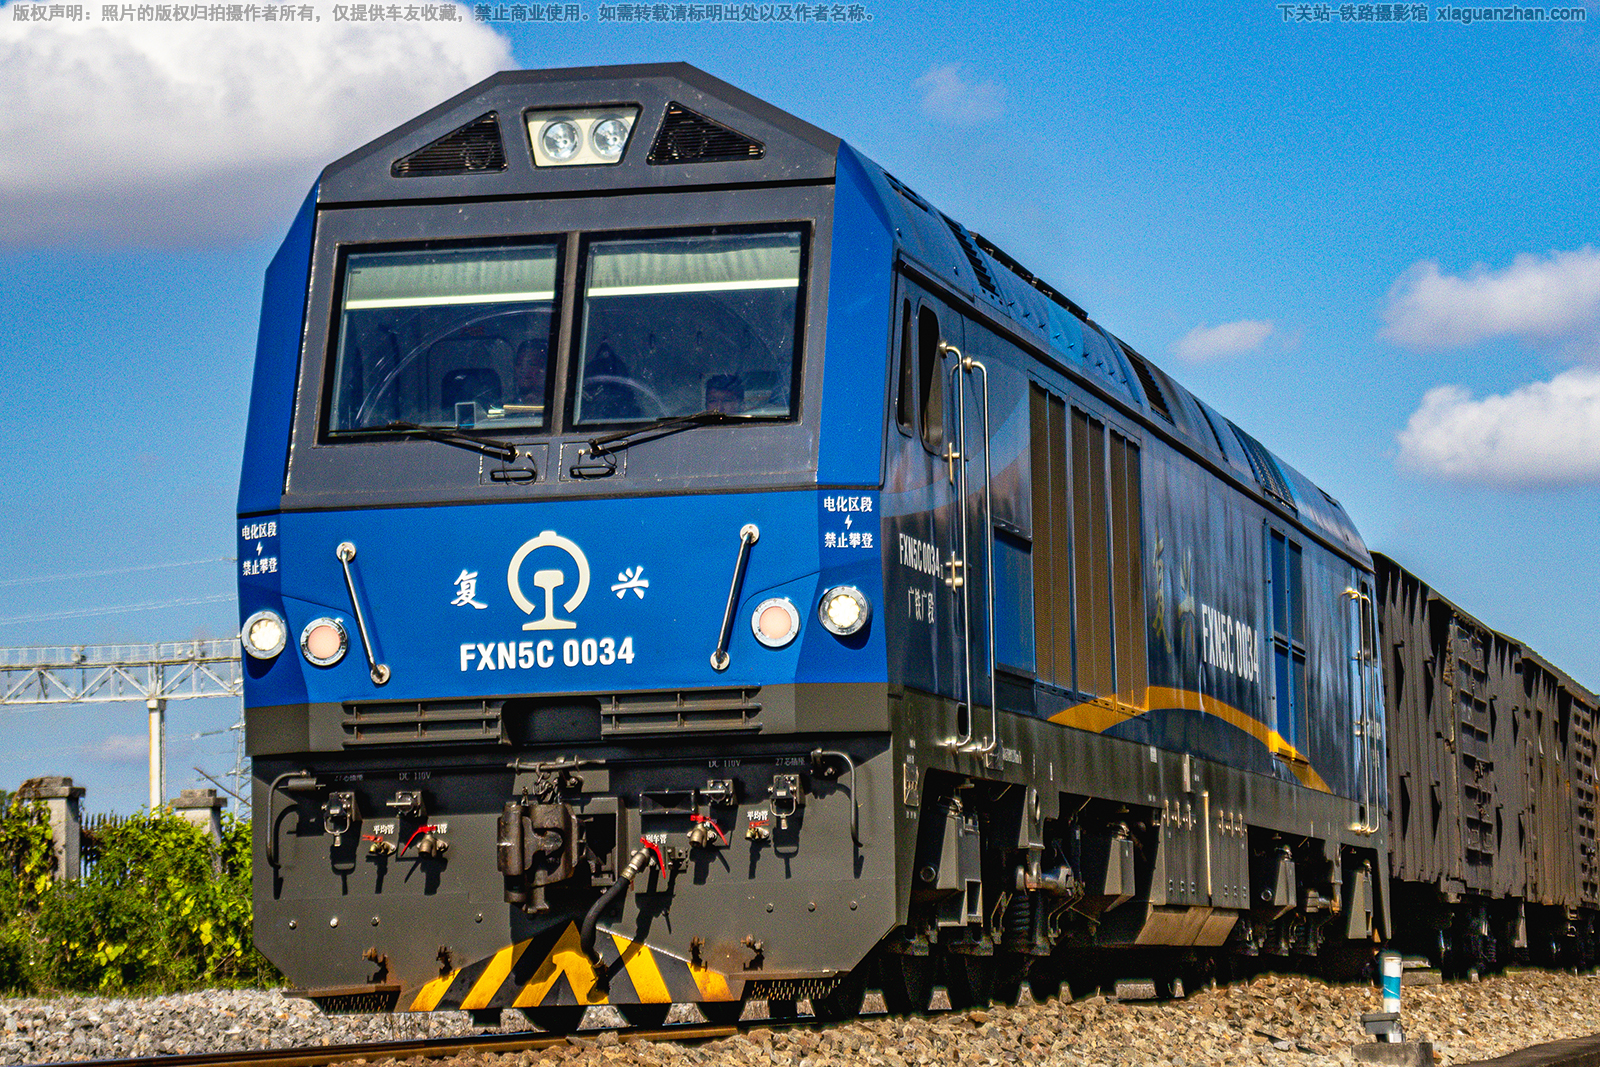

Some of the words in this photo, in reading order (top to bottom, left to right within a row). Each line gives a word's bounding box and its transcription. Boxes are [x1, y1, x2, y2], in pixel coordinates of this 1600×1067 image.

[824, 496, 873, 512] 电化区段
[241, 522, 277, 540] 电化区段
[824, 532, 873, 548] 禁止攀登
[899, 532, 922, 572] FXN5C
[922, 542, 940, 578] 0034
[242, 558, 278, 576] 禁止攀登
[450, 569, 488, 610] 复
[611, 565, 650, 600] 兴
[1202, 603, 1234, 674] FXN5C
[1235, 620, 1259, 683] 0034
[460, 642, 554, 672] FXN5C
[563, 637, 635, 667] 0034
[398, 772, 410, 781] DC
[414, 771, 431, 781] 110V
